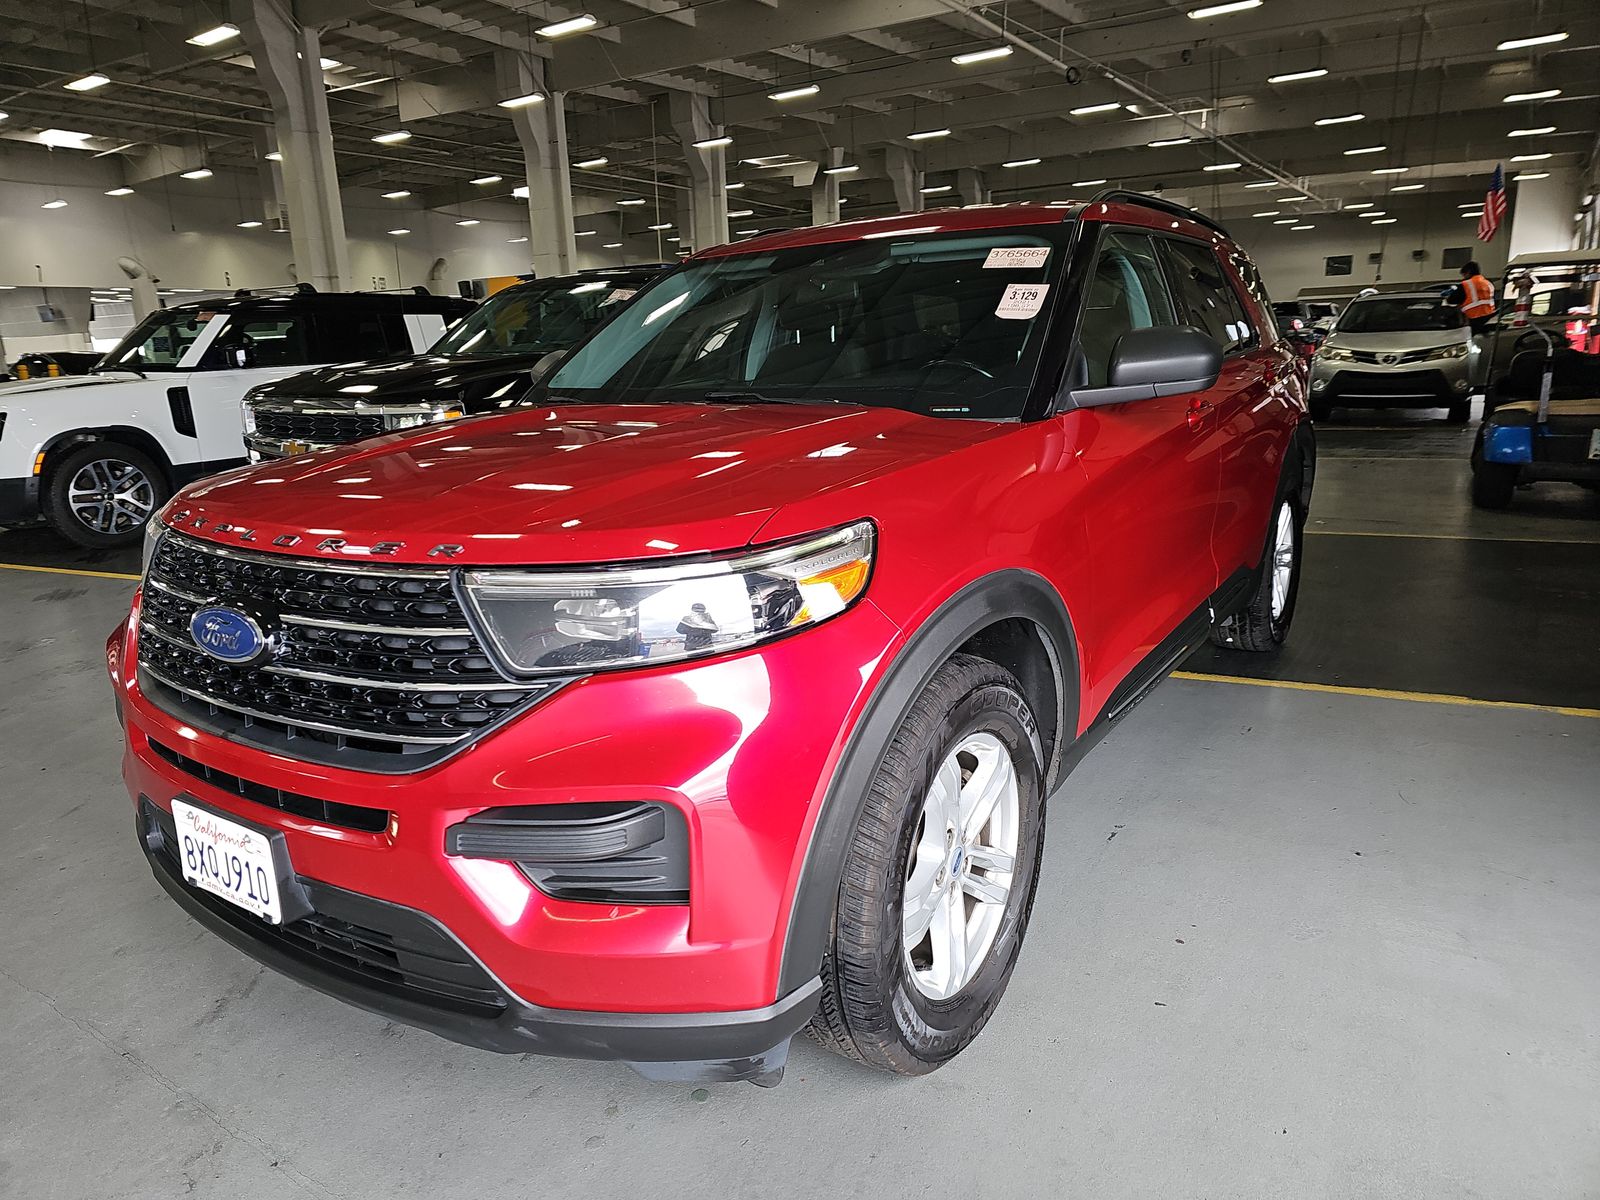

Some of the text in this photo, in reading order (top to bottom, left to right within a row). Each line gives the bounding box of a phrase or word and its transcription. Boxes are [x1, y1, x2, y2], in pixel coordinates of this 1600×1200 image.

[990, 249, 1048, 259] 3765664
[1009, 290, 1039, 301] 3:129
[172, 510, 465, 558] EXPLORER
[794, 547, 860, 573] EXPLORER
[202, 616, 241, 650] Ford
[970, 690, 1036, 738] COOPER
[193, 815, 248, 849] California
[184, 835, 270, 906] 8XQJ910
